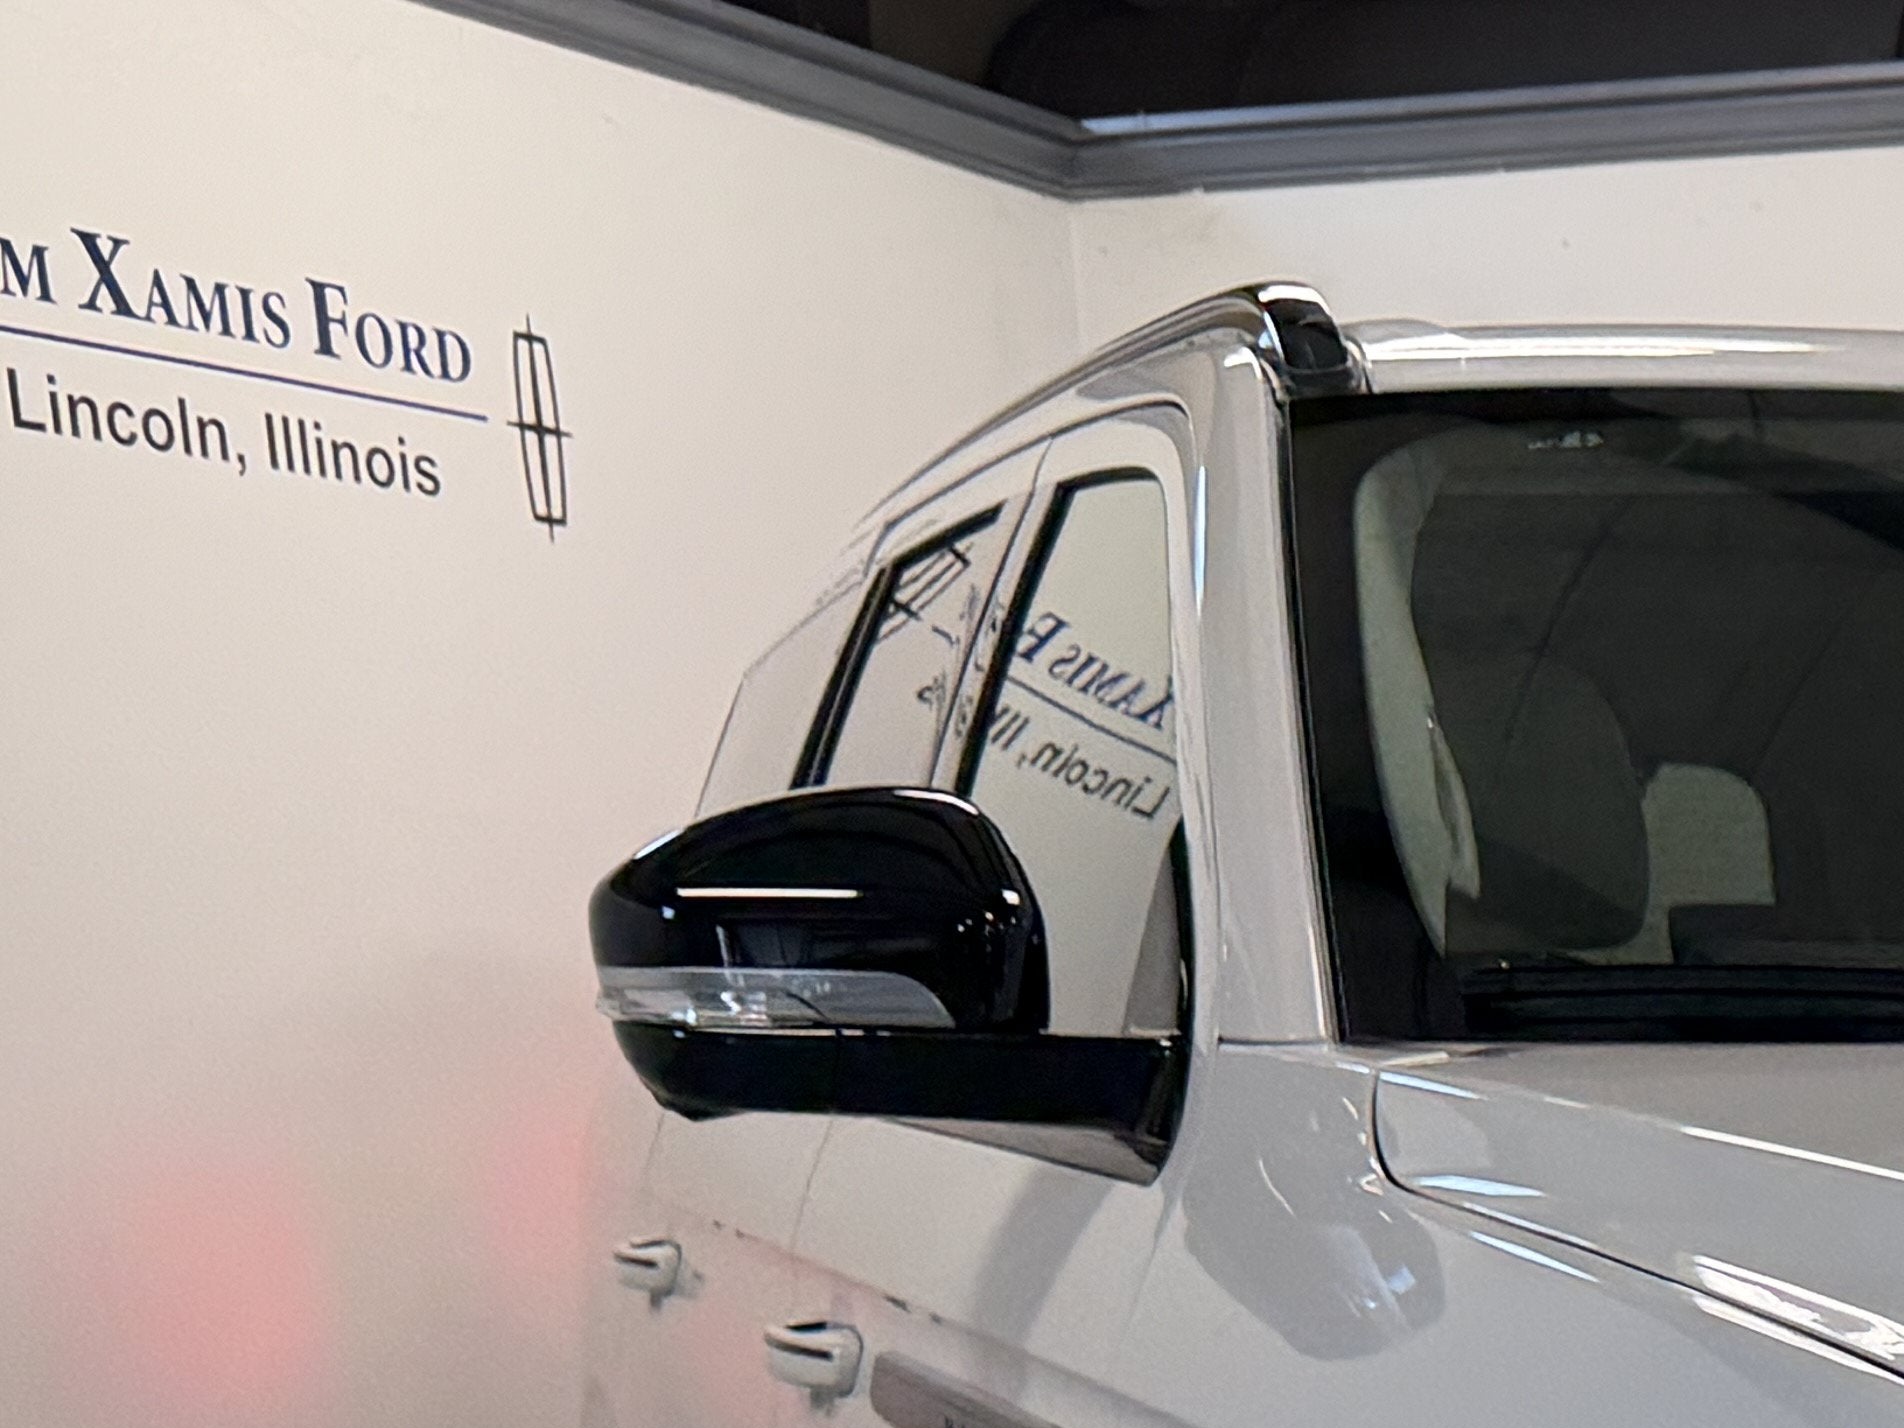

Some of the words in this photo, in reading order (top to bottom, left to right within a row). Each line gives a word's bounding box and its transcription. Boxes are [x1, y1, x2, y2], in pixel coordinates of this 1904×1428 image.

[70, 227, 291, 349] XAMIS
[305, 277, 472, 383] FORD
[7, 367, 248, 477] Lincoln,
[264, 412, 442, 497] Illinois
